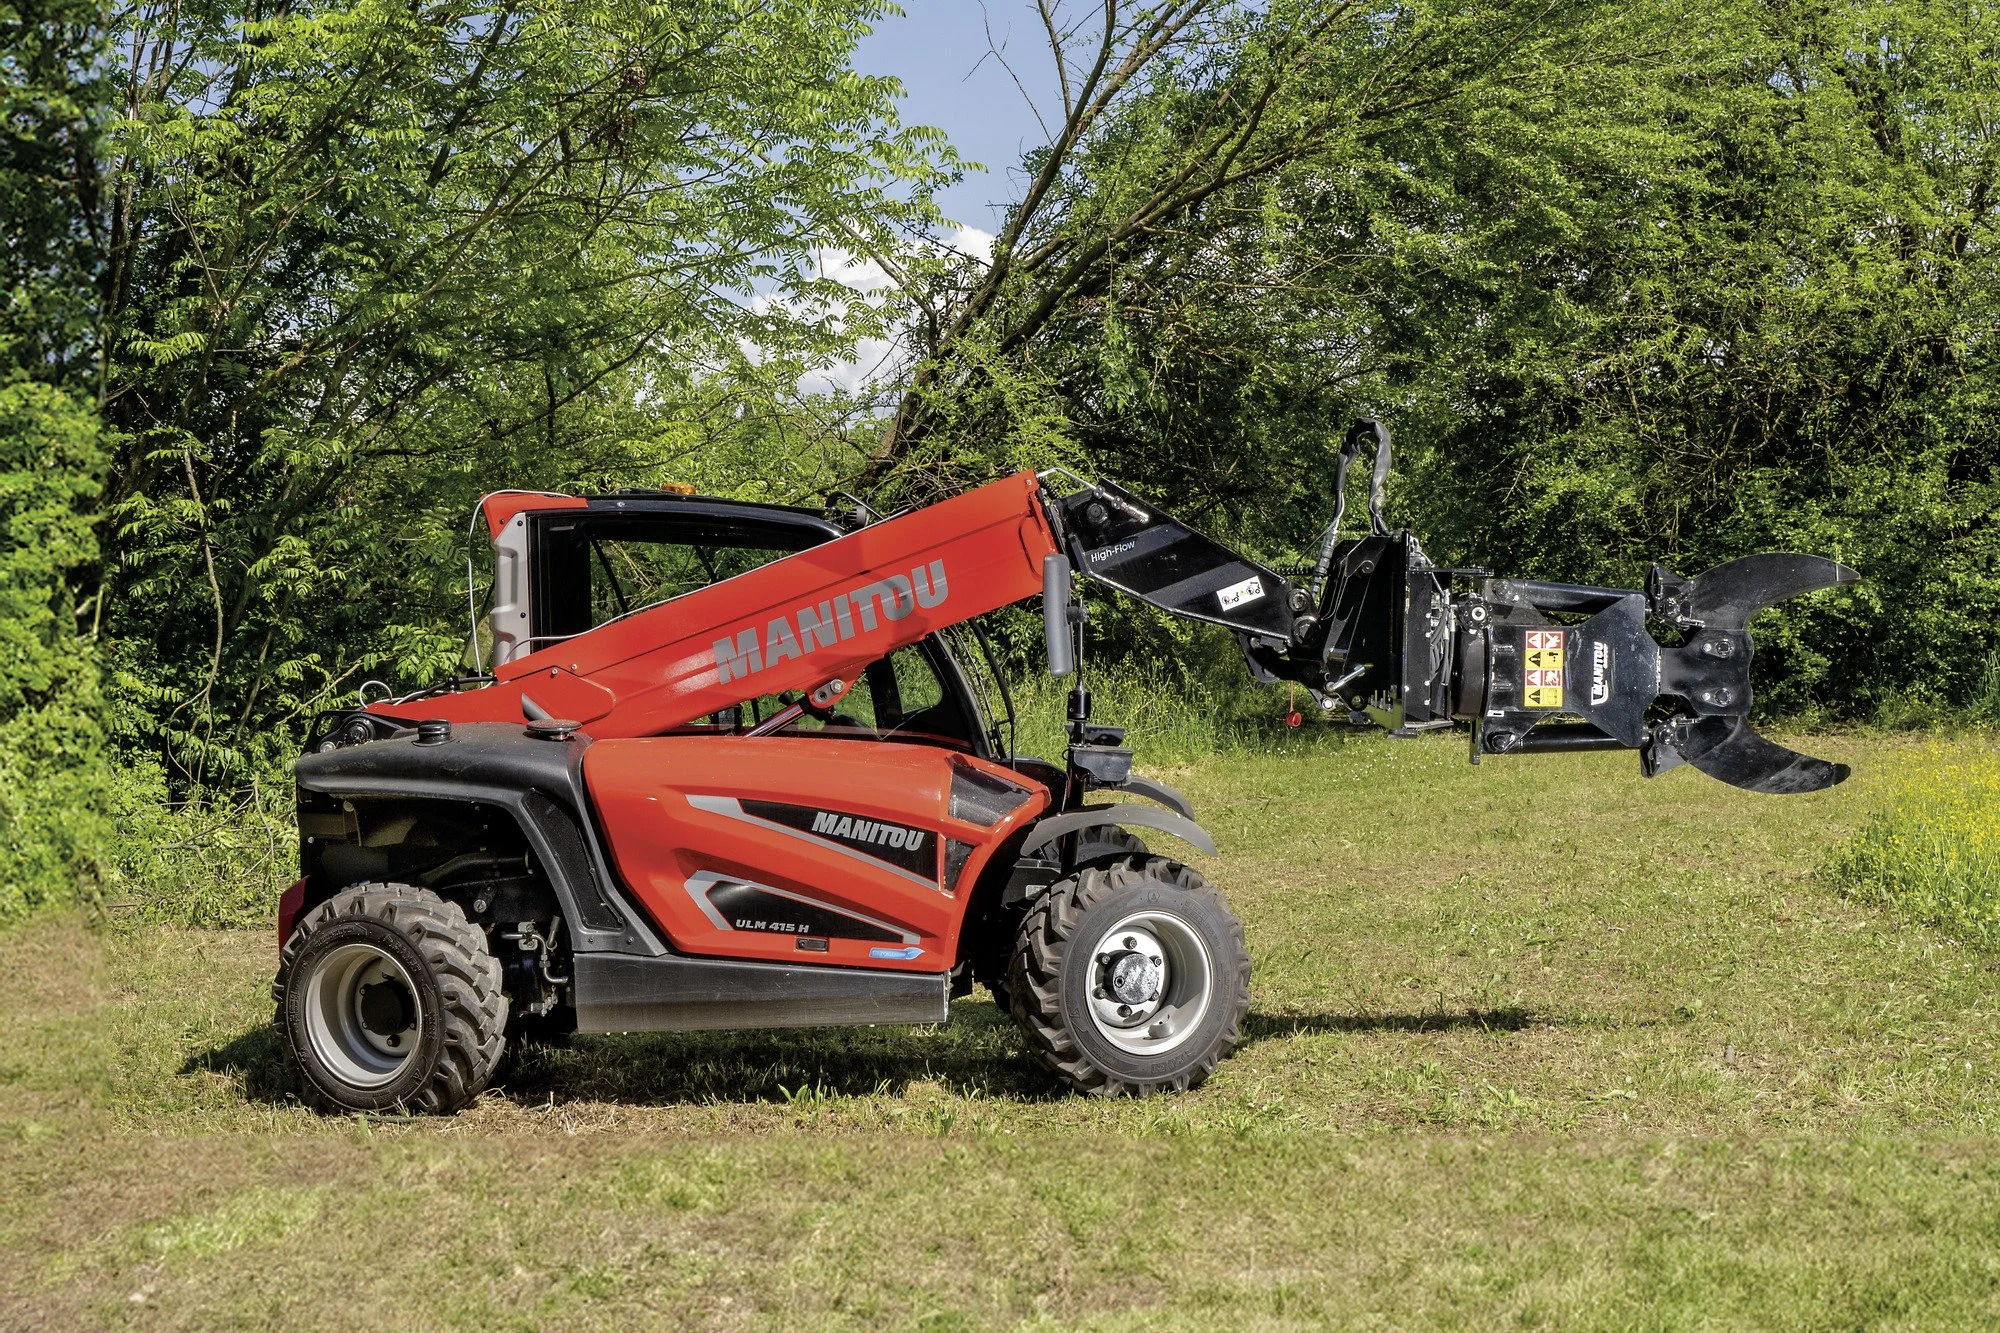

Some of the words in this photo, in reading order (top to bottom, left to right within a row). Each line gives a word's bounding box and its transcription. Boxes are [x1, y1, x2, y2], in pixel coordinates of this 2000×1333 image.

[1091, 541, 1135, 562] High-Flow
[713, 559, 949, 685] MANITOU
[811, 812, 925, 851] MANITOU
[736, 919, 767, 929] ULM
[769, 922, 795, 932] 415
[798, 924, 809, 933] H
